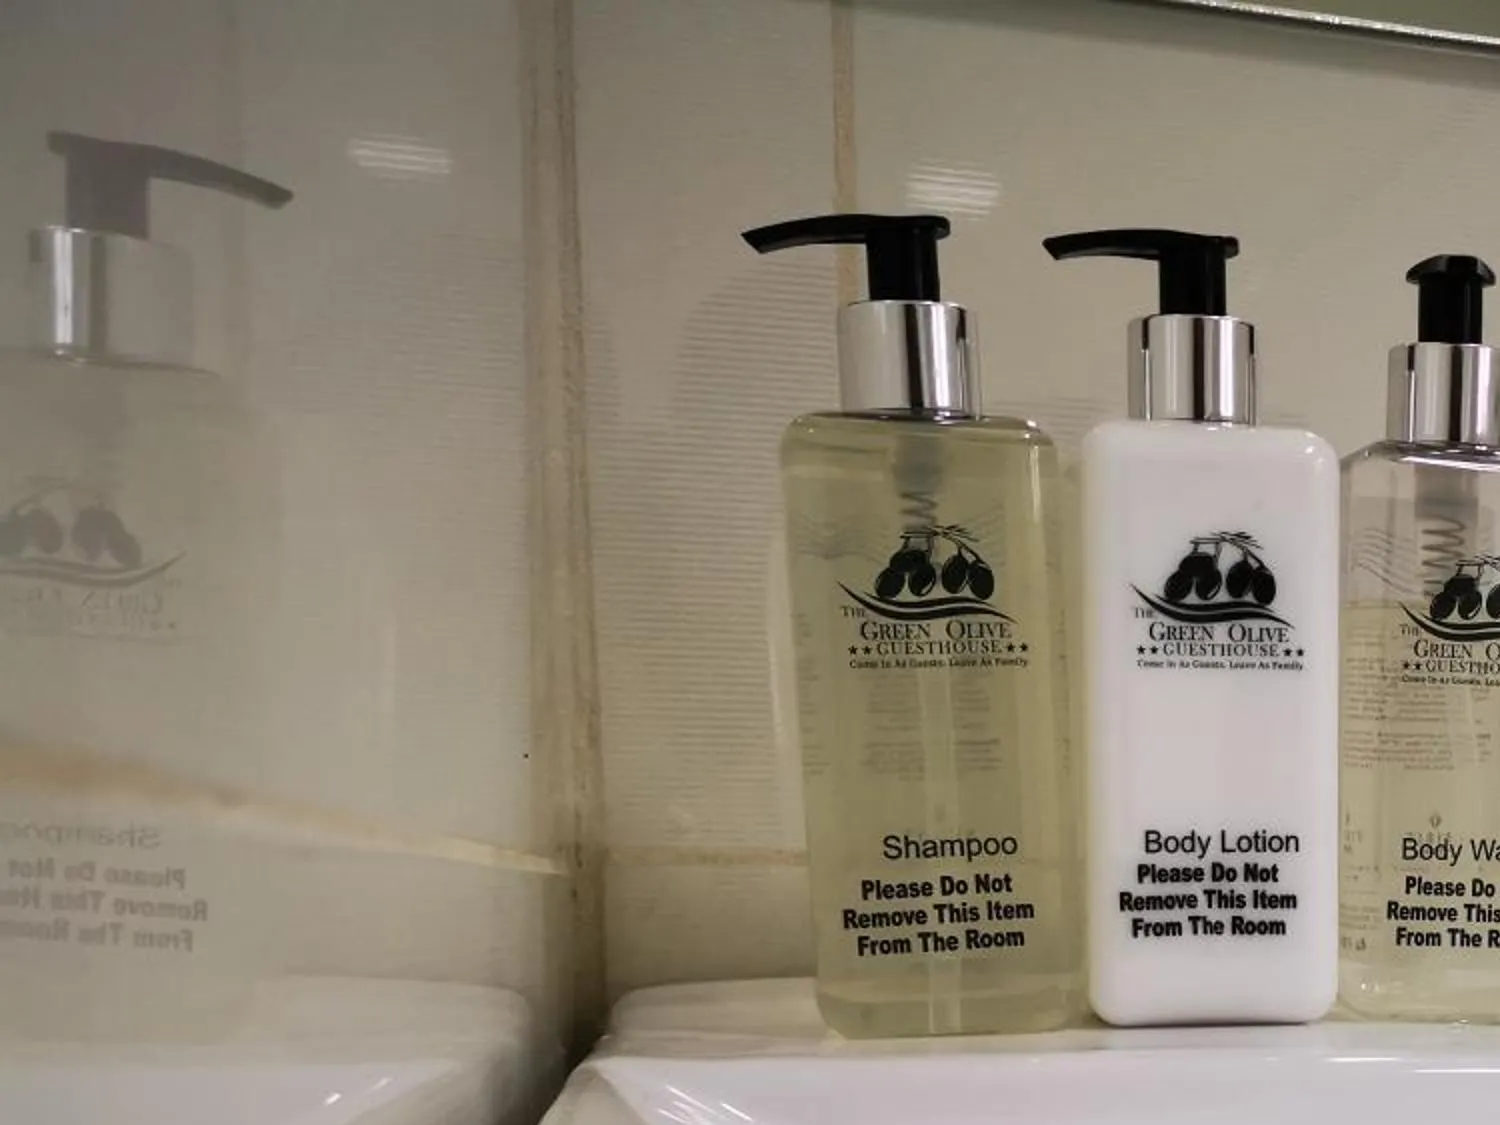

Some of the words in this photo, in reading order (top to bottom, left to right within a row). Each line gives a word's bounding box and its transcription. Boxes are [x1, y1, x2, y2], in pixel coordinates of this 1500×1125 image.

[860, 619, 931, 641] GREEN
[945, 619, 1013, 640] OLIVE
[1149, 621, 1215, 642] GREEN
[1227, 623, 1290, 643] OLIVE
[876, 639, 1003, 656] GUESTHOUSE
[1162, 642, 1280, 657] GUESTHOUSE
[1413, 639, 1473, 659] GREEN
[895, 658, 907, 670] As
[979, 657, 993, 668] As
[995, 656, 1028, 669] Family
[1179, 659, 1191, 669] As
[1258, 660, 1271, 671] As
[1272, 660, 1303, 673] Family
[883, 835, 1018, 862] Shampoo
[1144, 829, 1212, 859] Body
[1220, 829, 1300, 853] Lotion
[1402, 837, 1463, 867] Body
[1137, 863, 1205, 884] Please
[1211, 862, 1238, 882] Do
[1243, 863, 1279, 883] Not
[861, 879, 934, 901] Please
[939, 875, 969, 897] Do
[974, 872, 1013, 894] Not
[1405, 875, 1466, 897] Please
[1471, 878, 1496, 899] Do
[1119, 891, 1199, 912] Remove
[1203, 889, 1247, 909] This
[1252, 889, 1298, 909] Item
[1386, 900, 1459, 922] Remove
[843, 908, 928, 930] Remove
[933, 902, 981, 924] This
[987, 900, 1035, 921] Item
[1132, 917, 1183, 938] From
[1188, 915, 1225, 935] The
[1231, 915, 1287, 936] Room
[1395, 926, 1442, 947] From
[1446, 928, 1483, 948] The
[858, 936, 912, 957] From
[917, 931, 959, 952] The
[965, 929, 1025, 950] Room
